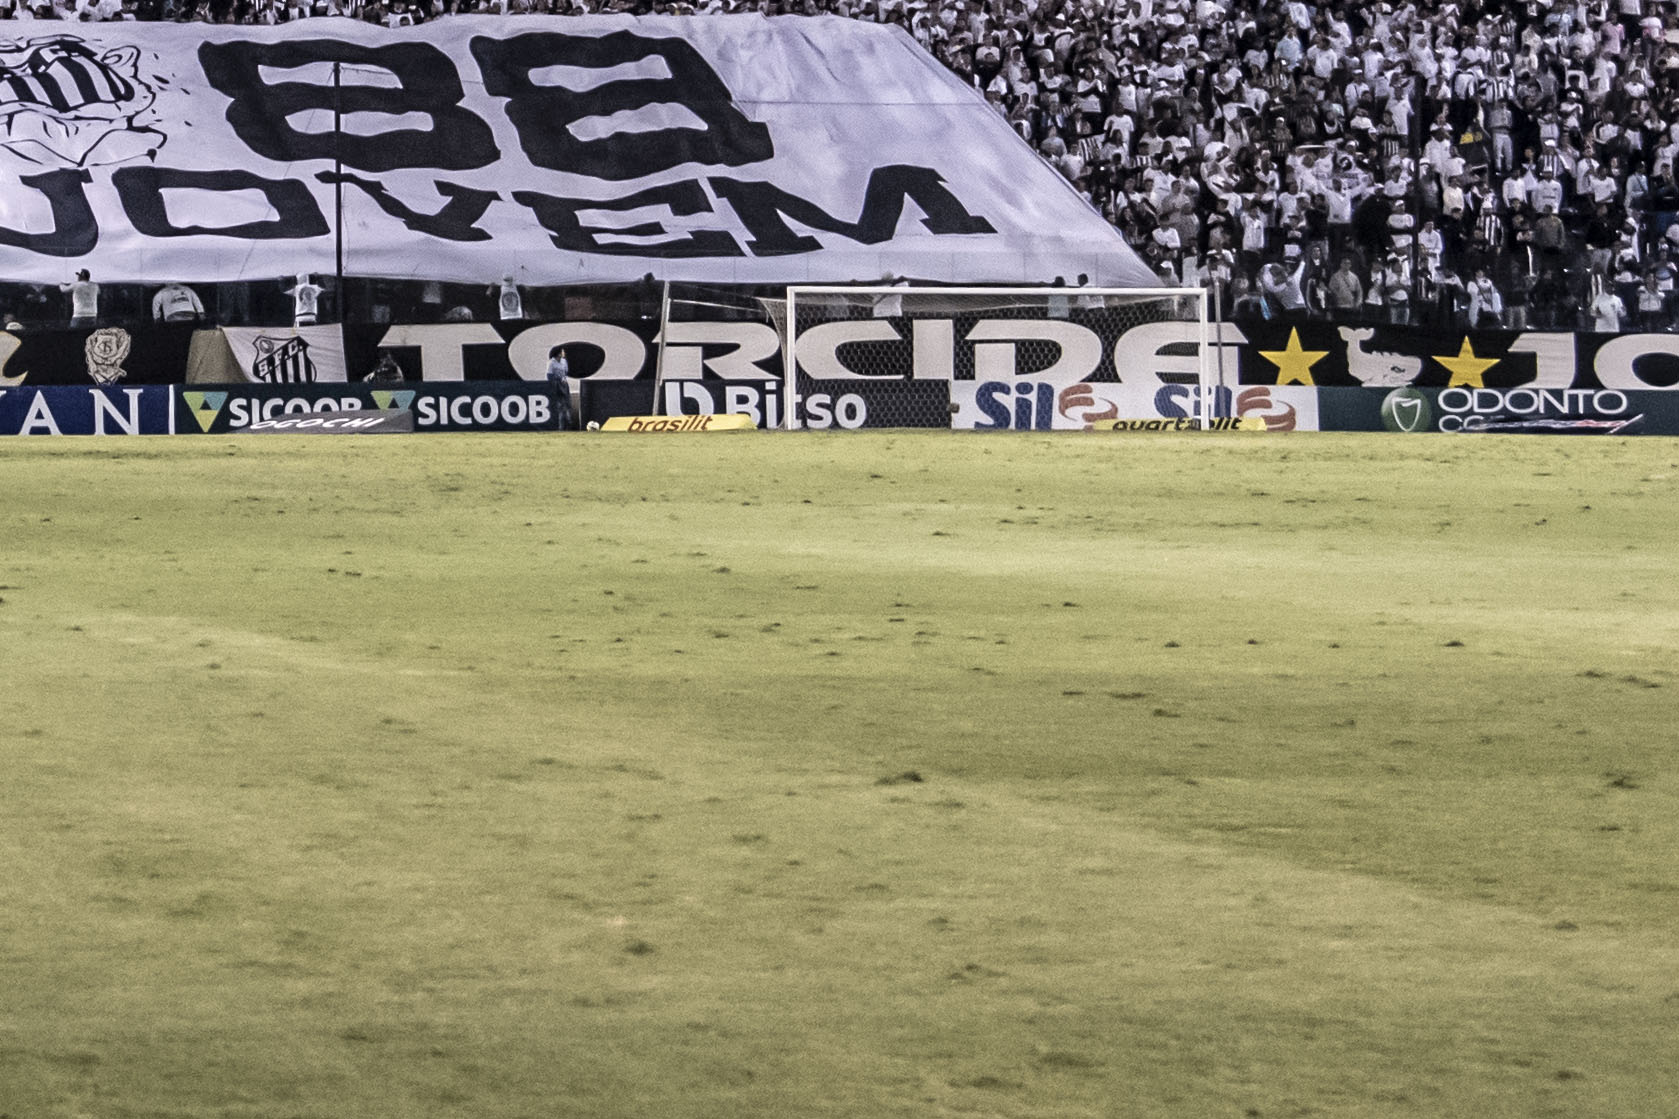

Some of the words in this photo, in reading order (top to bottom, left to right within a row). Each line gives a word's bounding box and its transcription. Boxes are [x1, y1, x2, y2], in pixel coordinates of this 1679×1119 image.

[197, 29, 775, 181] 88
[377, 320, 1249, 386] TORCIDA
[417, 394, 551, 426] SICOOB
[1438, 387, 1628, 415] ODONTO
[250, 417, 386, 430] OGOCHI
[627, 414, 714, 432] brasilit
